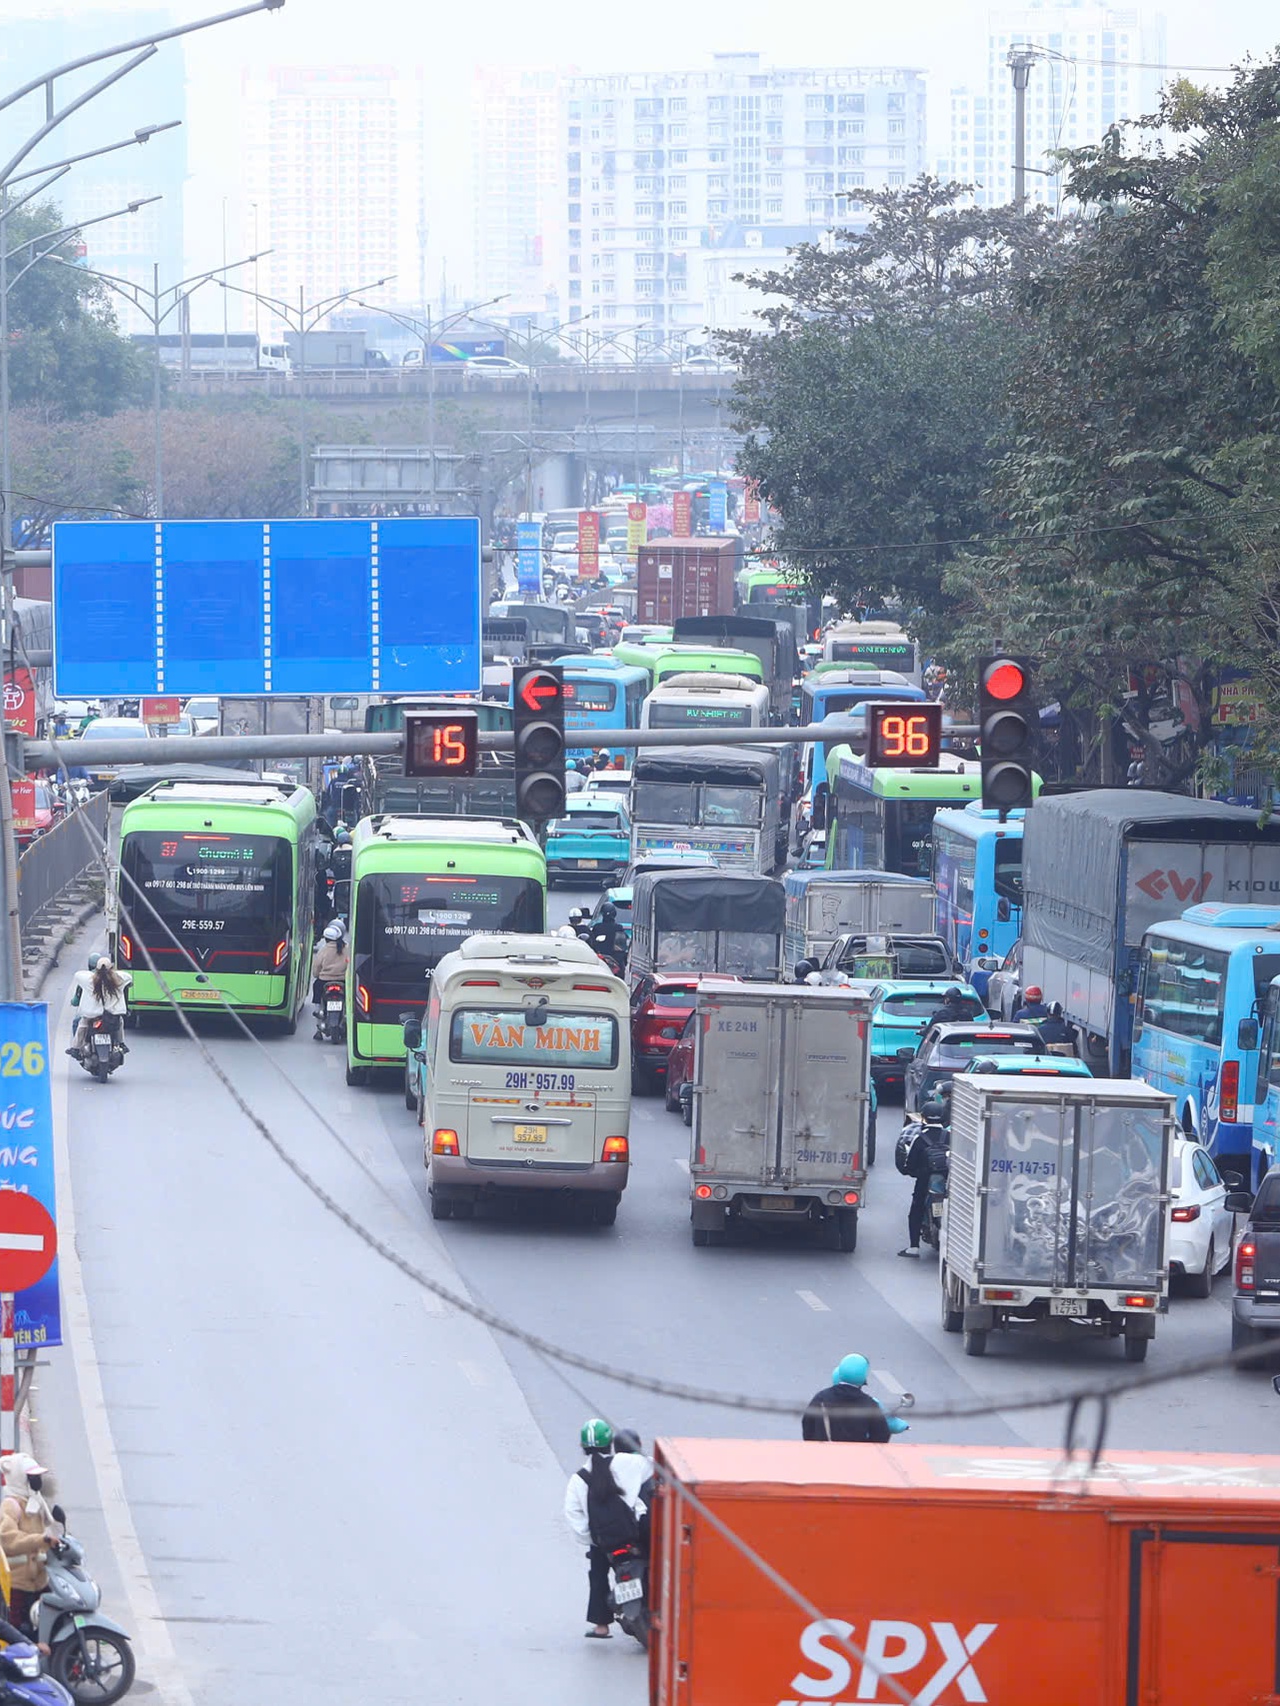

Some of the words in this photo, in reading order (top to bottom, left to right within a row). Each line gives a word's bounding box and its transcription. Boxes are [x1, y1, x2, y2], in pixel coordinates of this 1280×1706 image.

[882, 716, 929, 755] 96
[433, 725, 466, 764] 15
[153, 880, 165, 888] 0917
[177, 881, 186, 889] 298
[182, 920, 224, 930] 29E-559.57
[394, 926, 407, 934] 0917
[408, 926, 418, 934] 601
[420, 927, 429, 935] 298
[718, 1021, 732, 1031] XE
[470, 1018, 525, 1048] VĂN
[534, 1027, 600, 1051] MINH
[797, 1150, 852, 1164] 29H-781.97
[991, 1159, 1056, 1174] 29K-147-51
[790, 1619, 998, 1702] SPX
